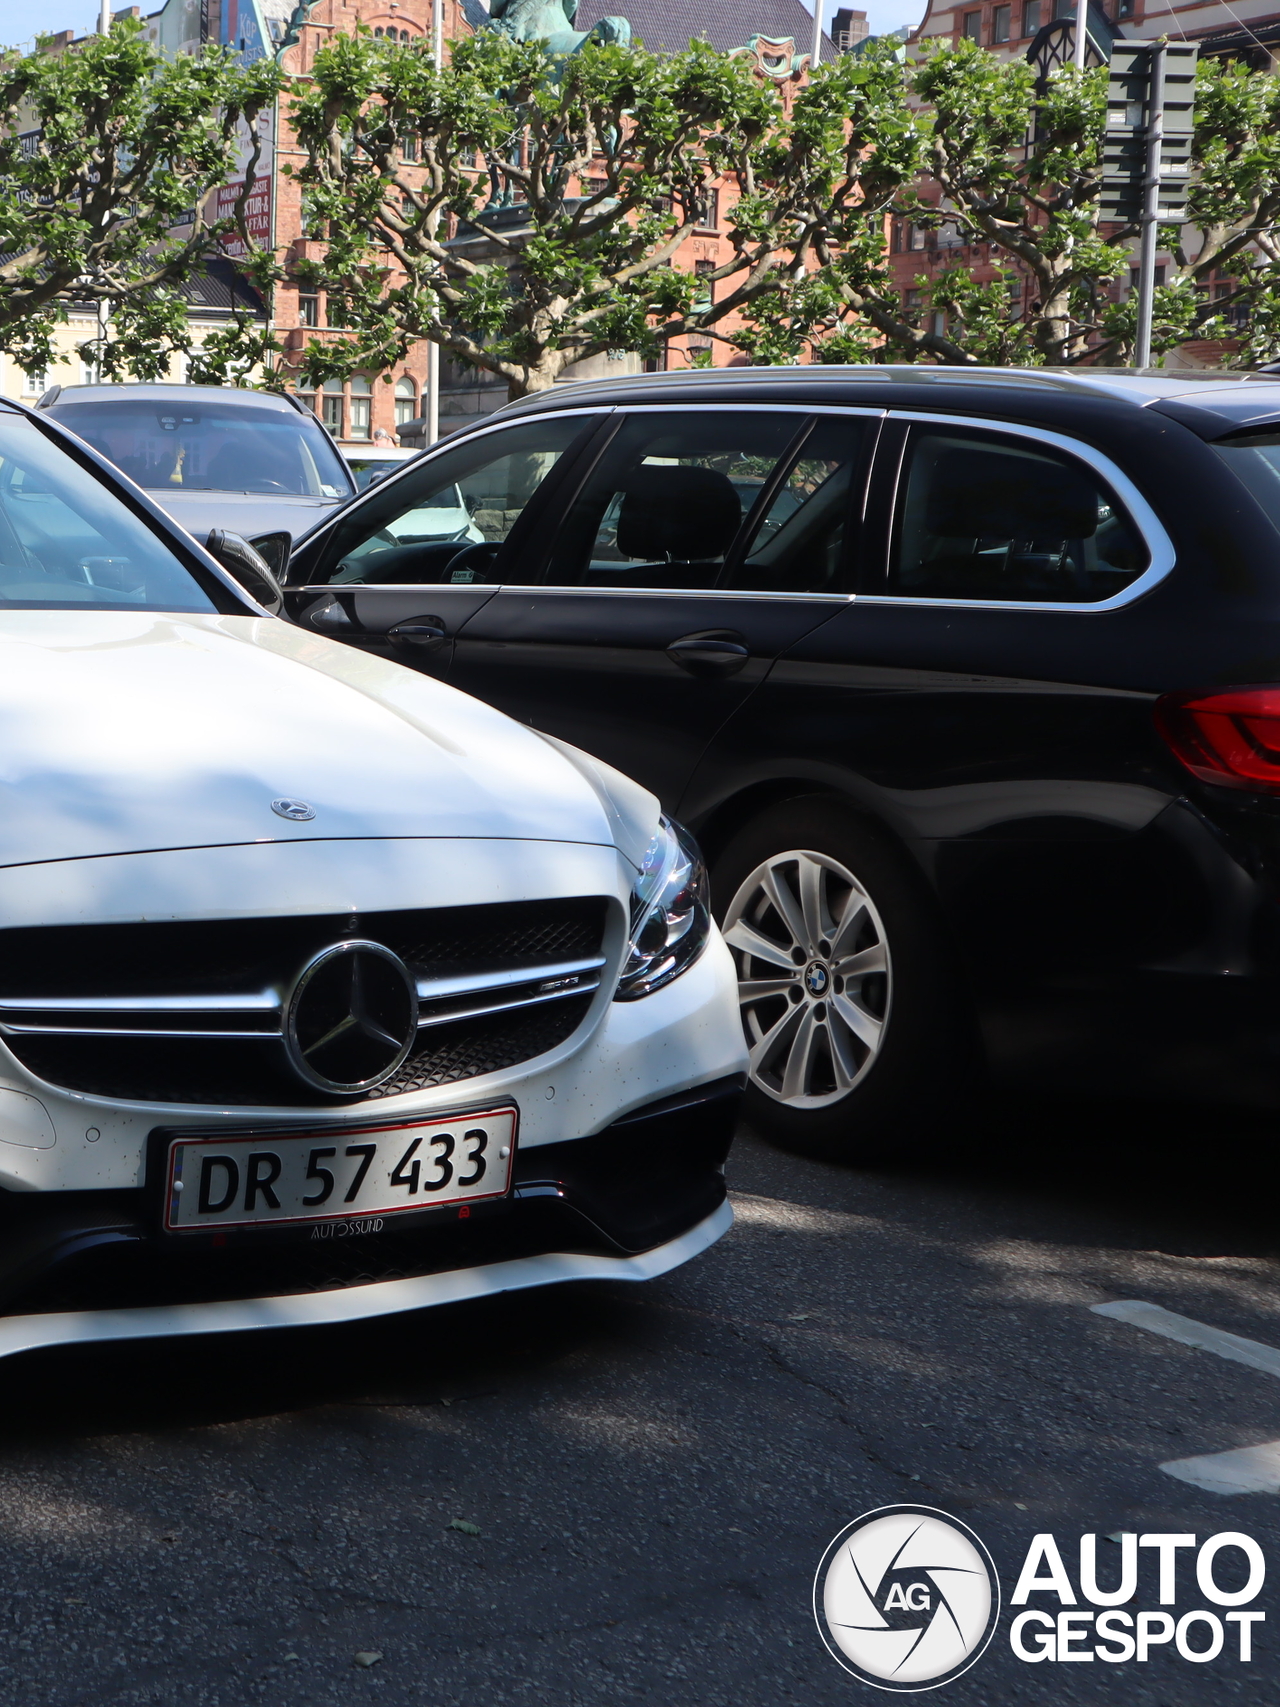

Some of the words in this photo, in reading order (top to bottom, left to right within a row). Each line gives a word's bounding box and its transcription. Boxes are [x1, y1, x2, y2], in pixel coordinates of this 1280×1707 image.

[198, 1151, 282, 1214] DR
[302, 1143, 377, 1206] 57
[390, 1128, 488, 1194] 433
